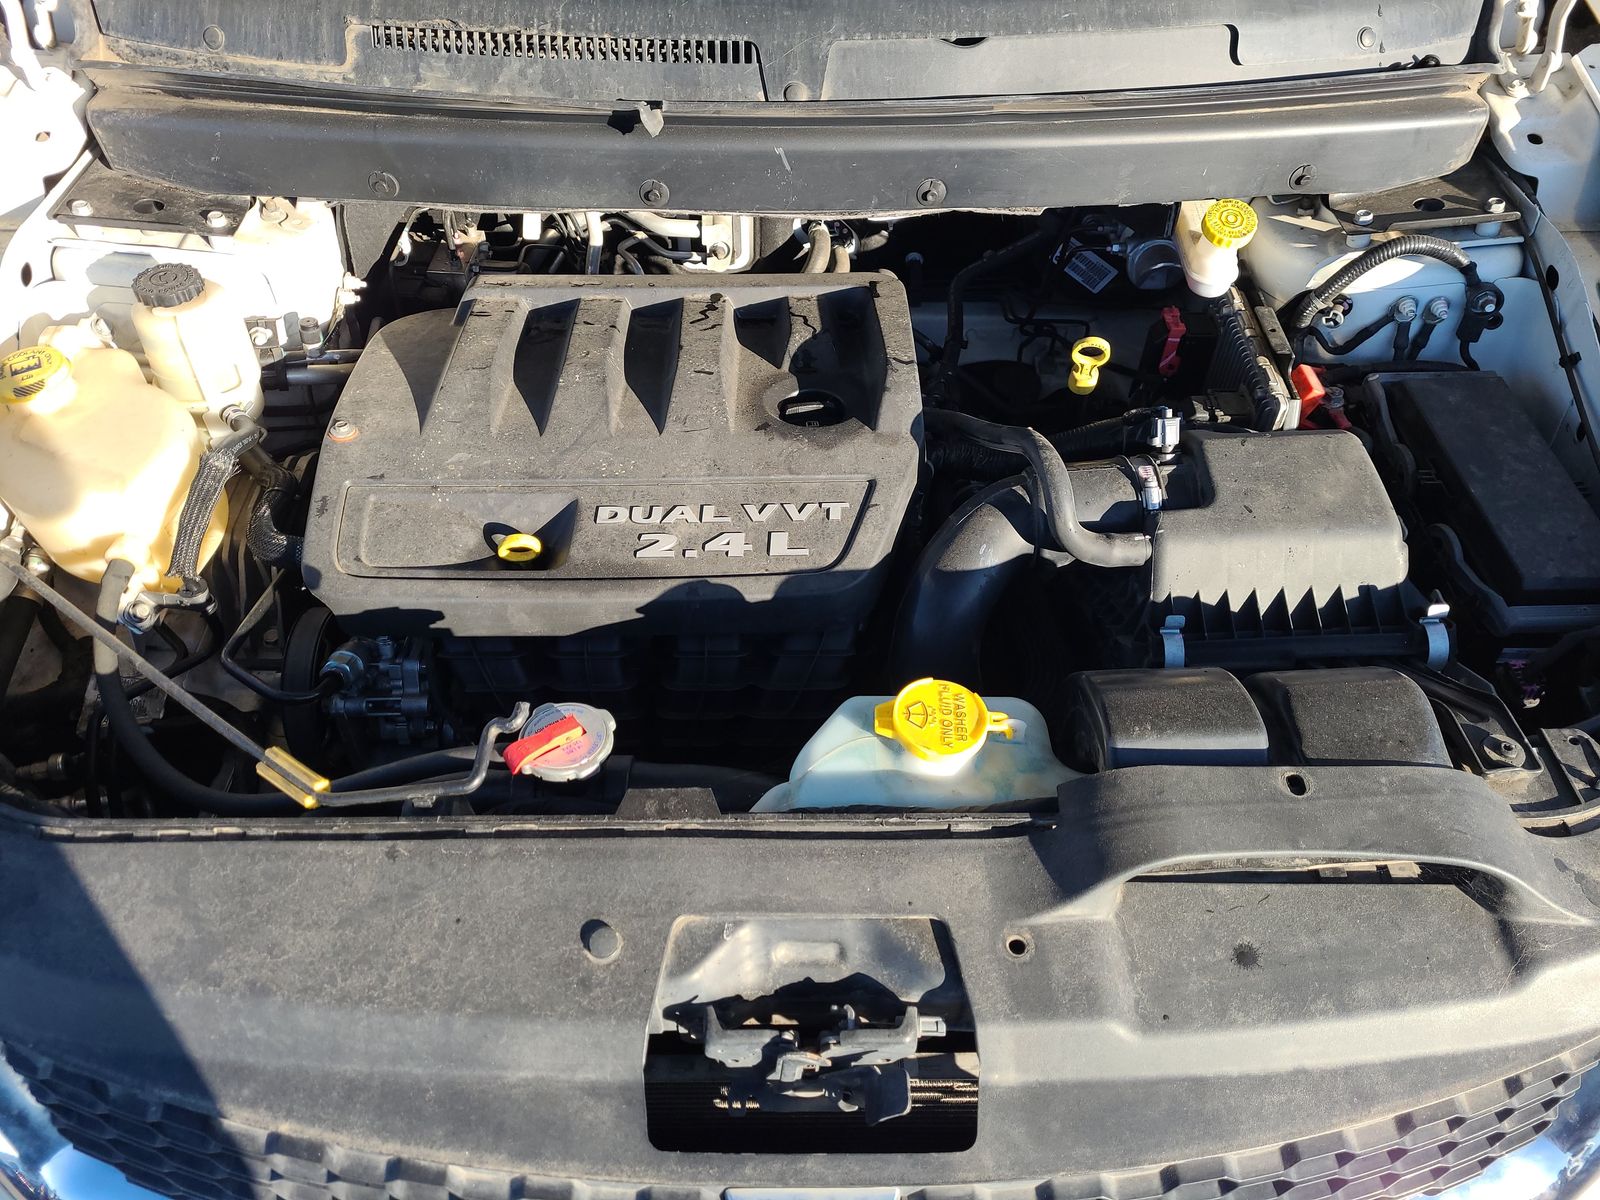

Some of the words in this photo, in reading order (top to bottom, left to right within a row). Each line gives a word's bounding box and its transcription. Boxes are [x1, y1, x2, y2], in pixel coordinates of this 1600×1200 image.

[593, 504, 732, 525] DUAL
[740, 502, 851, 522] VVT
[633, 531, 753, 559] 2.4
[766, 530, 811, 557] L
[938, 684, 953, 716] FLUID
[953, 693, 968, 742] WASHER
[940, 719, 954, 748] ONLY
